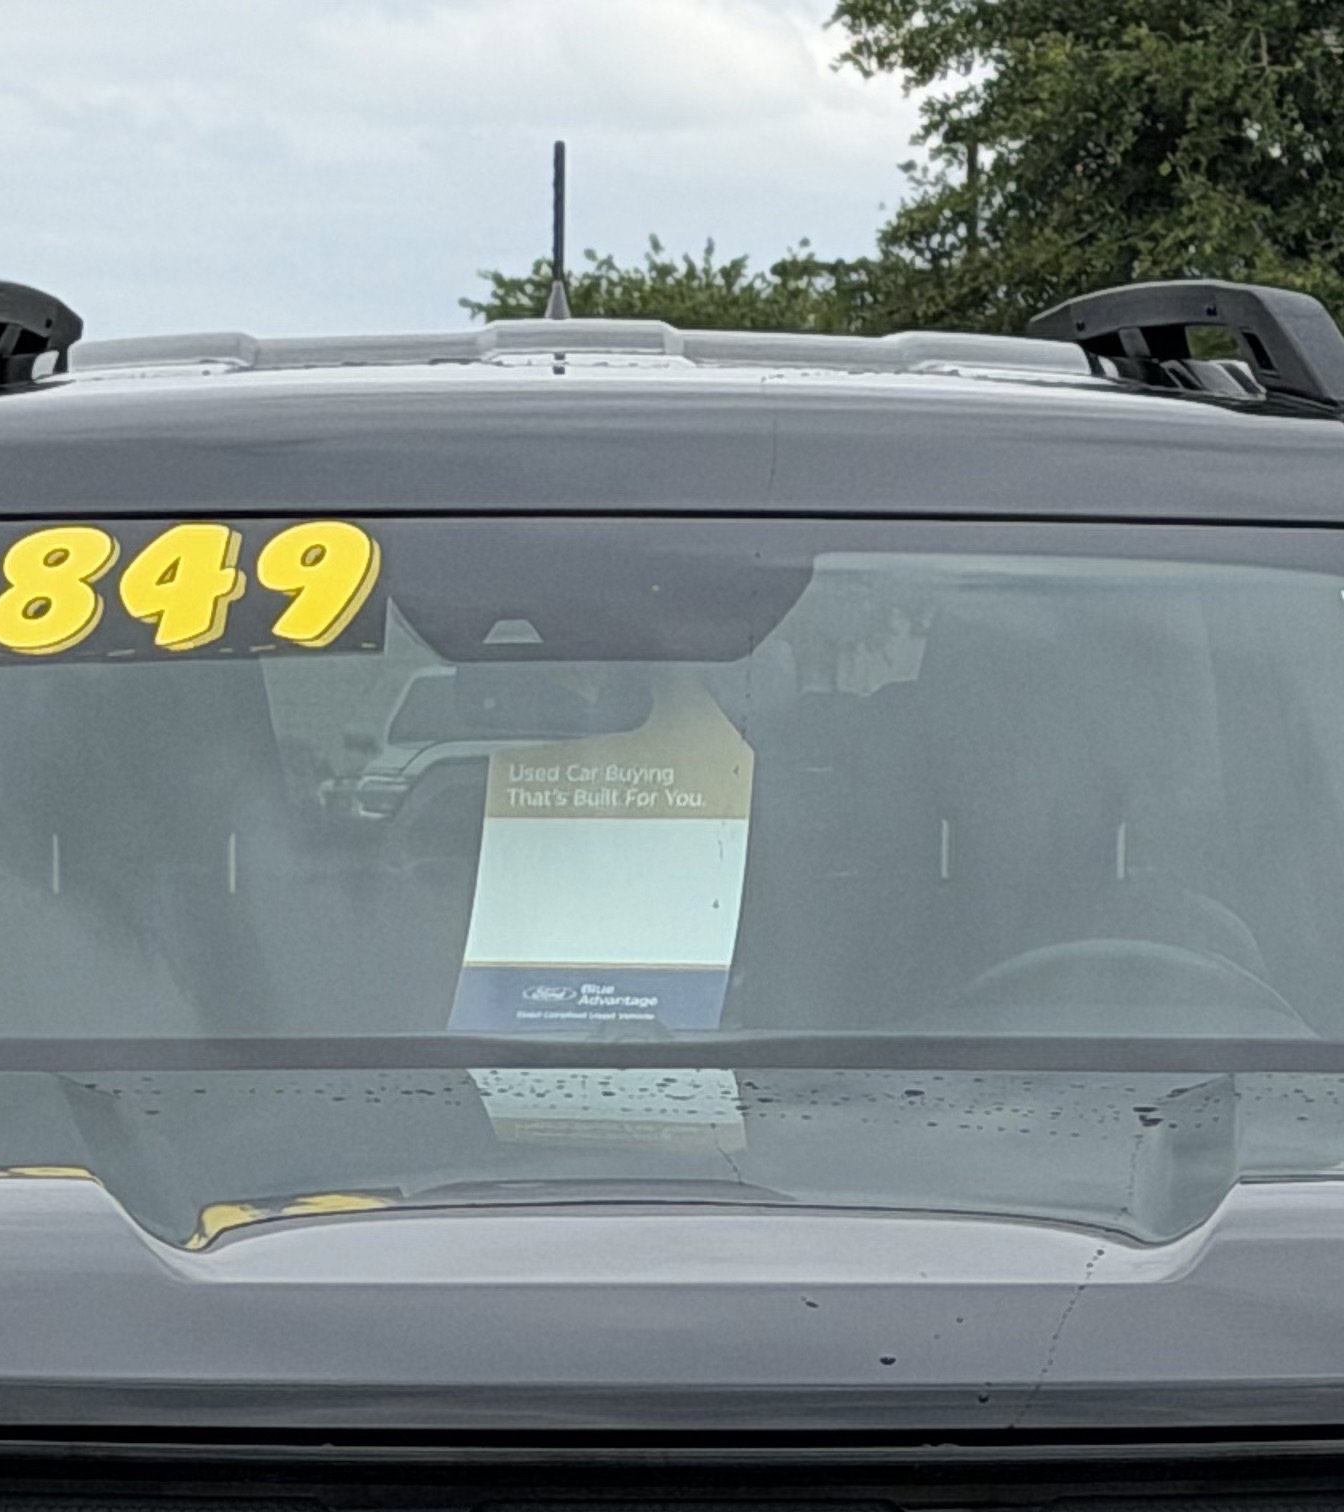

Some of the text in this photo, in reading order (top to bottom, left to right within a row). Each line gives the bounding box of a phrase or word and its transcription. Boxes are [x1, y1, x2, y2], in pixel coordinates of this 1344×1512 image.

[509, 763, 674, 786] Used Car Buying
[507, 787, 705, 807] That's Built For You.
[577, 995, 659, 1009] Advantage
